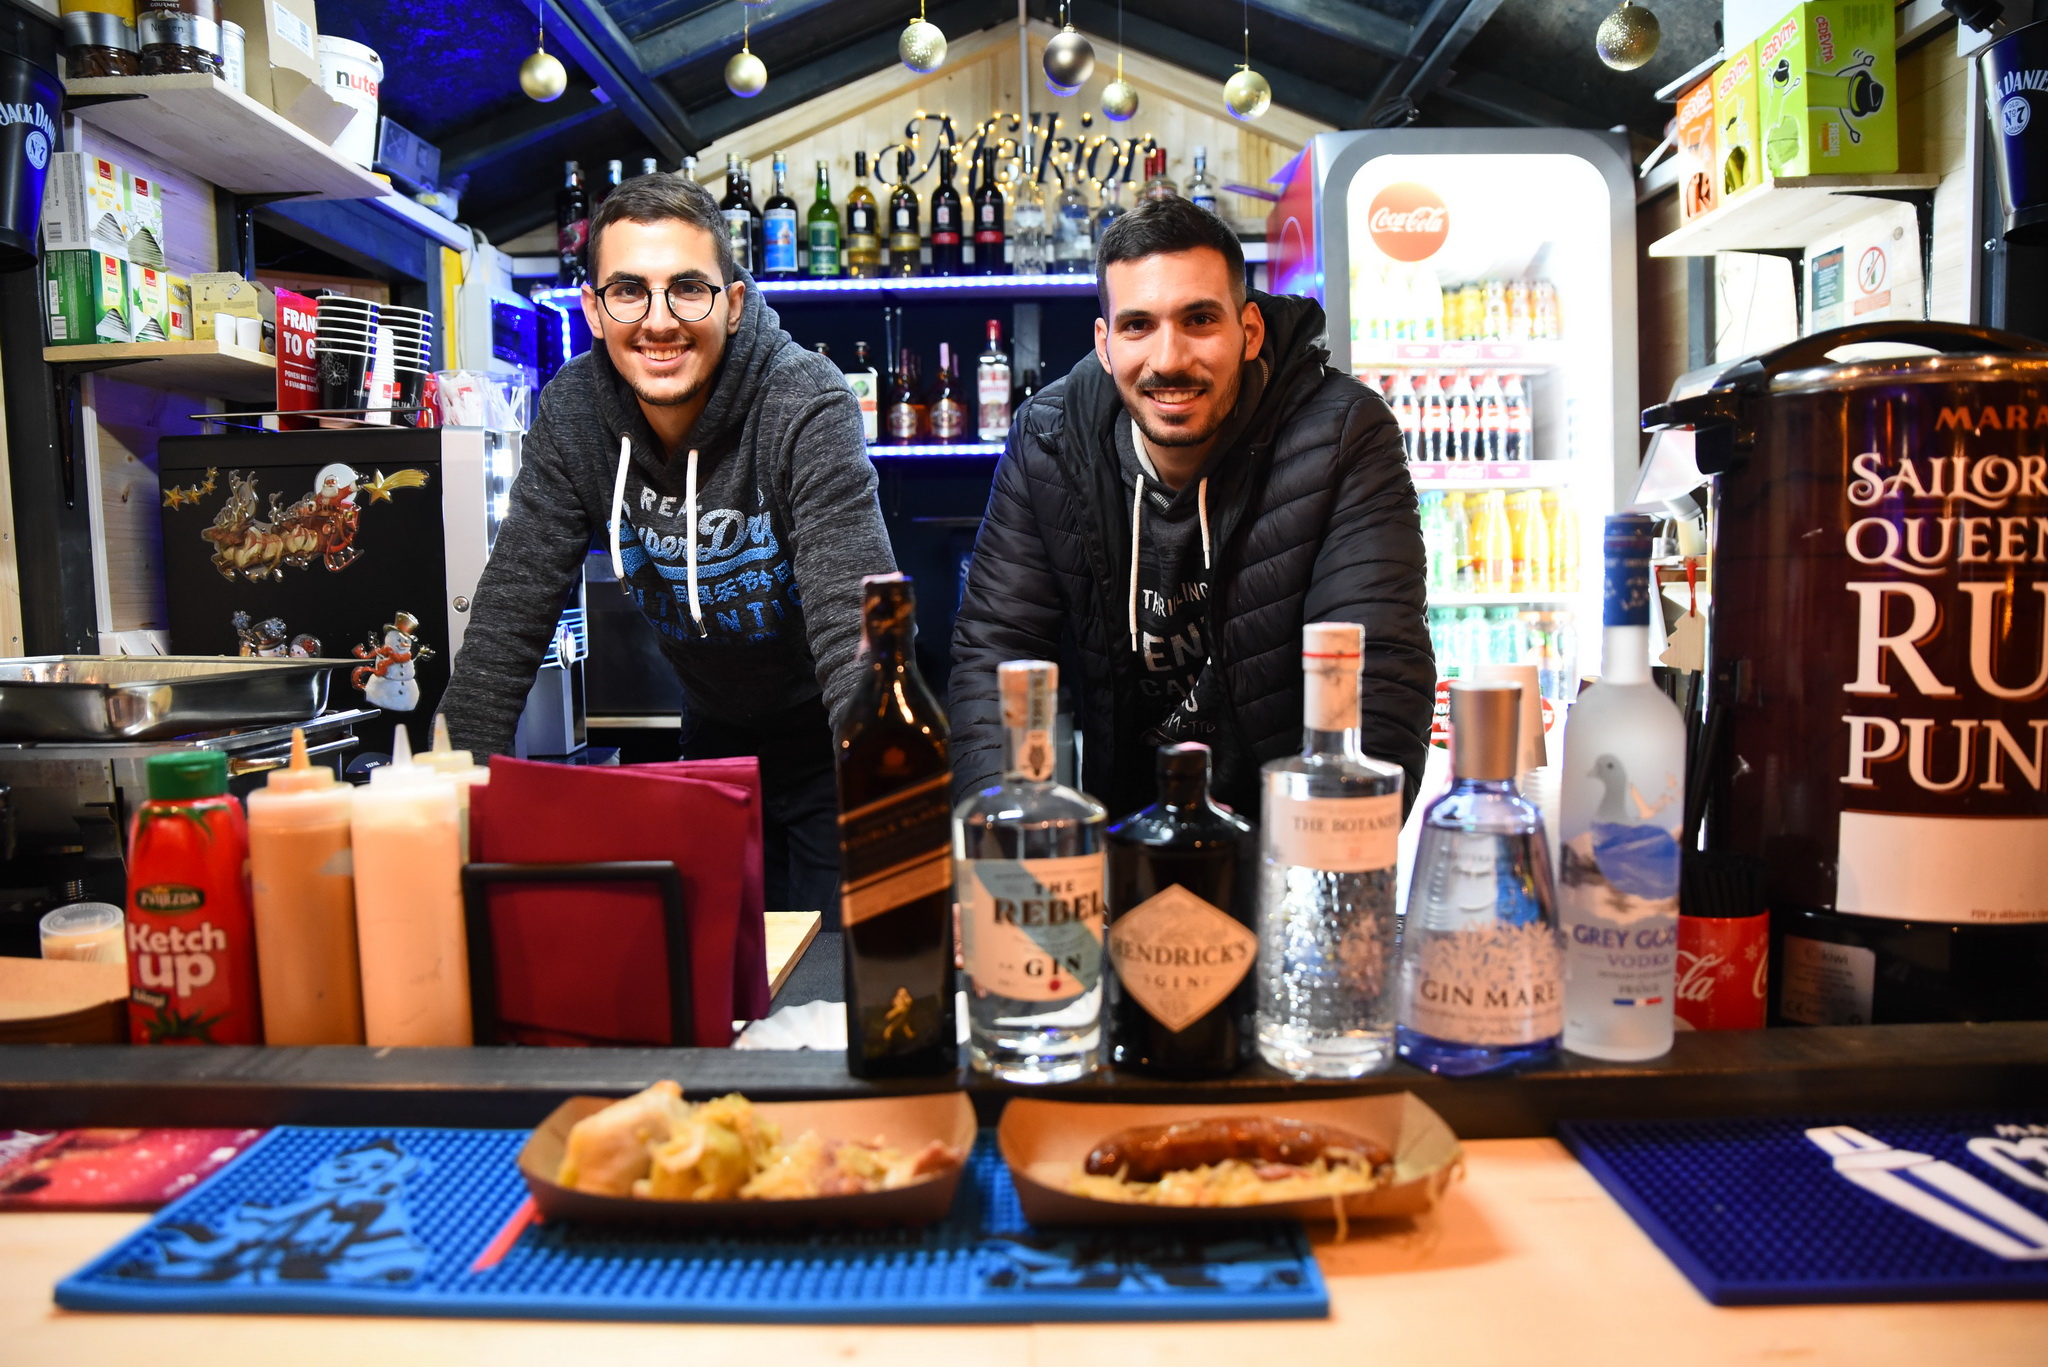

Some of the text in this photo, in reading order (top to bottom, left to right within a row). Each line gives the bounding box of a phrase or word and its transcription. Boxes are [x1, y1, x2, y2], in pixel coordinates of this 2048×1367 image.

[1760, 18, 1799, 69] CEDEVITA
[1815, 15, 1836, 64] CEDEVITA
[1369, 206, 1447, 233] Coca-Cola
[283, 330, 302, 356] TO
[1034, 882, 1075, 895] THE
[128, 921, 227, 952] Ketch
[1573, 923, 1629, 948] GREY
[138, 952, 216, 998] up
[1025, 952, 1083, 977] GIN
[1420, 979, 1557, 1009] GIN MARE
